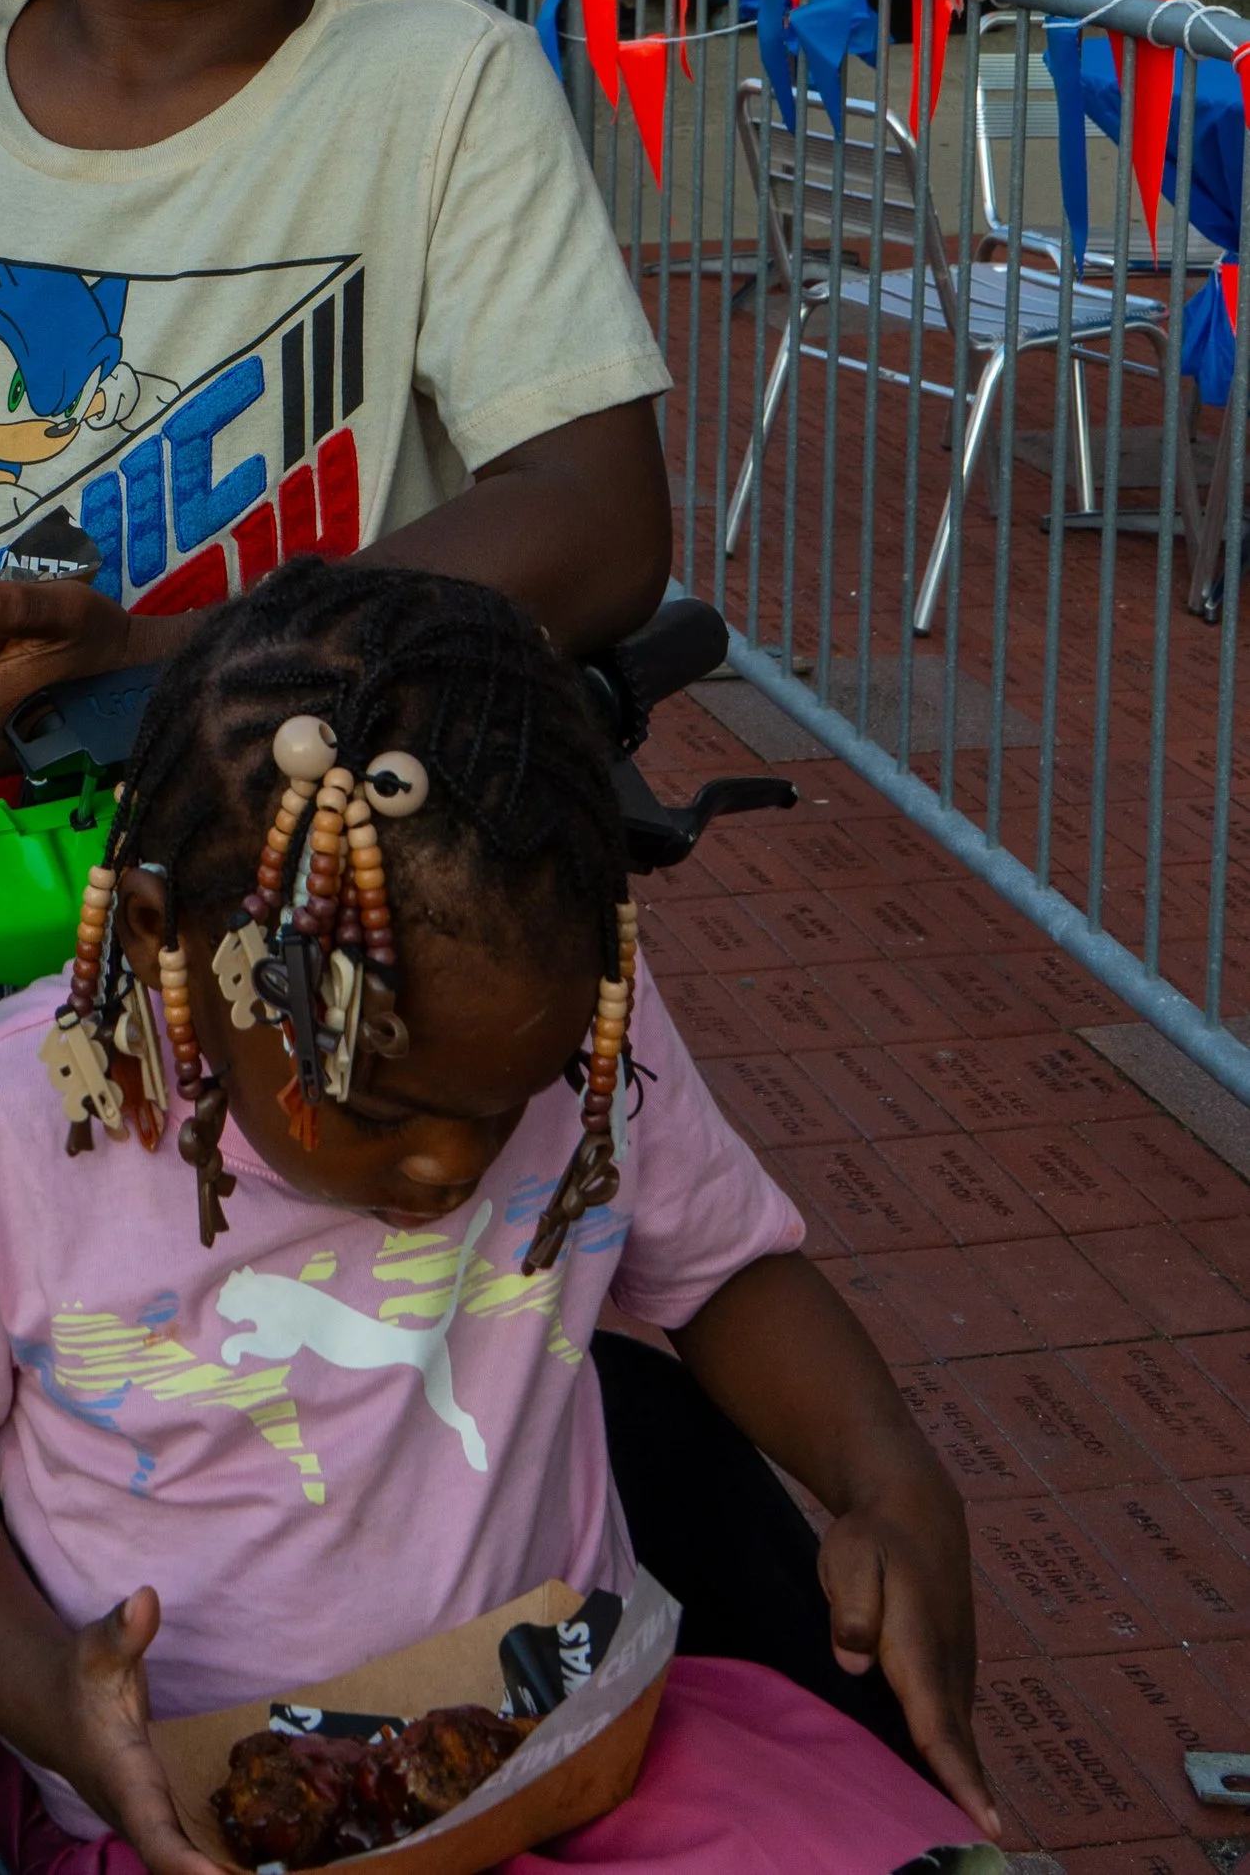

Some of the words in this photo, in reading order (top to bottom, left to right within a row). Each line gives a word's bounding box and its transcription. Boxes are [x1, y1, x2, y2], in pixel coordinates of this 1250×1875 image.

[728, 1062, 772, 1096] ARLENE
[763, 1101, 806, 1135] VICTOR
[765, 1078, 810, 1112] MEMORY
[832, 1052, 883, 1091] MILDRED
[830, 1152, 884, 1198] ANGELINA
[872, 1202, 914, 1233] DALLA
[1119, 1502, 1170, 1542] MARY
[1018, 1539, 1086, 1604] CASIMIR
[1022, 1508, 1050, 1522] IN
[1041, 1533, 1115, 1601] MEMORY
[1105, 1611, 1141, 1633] OF
[988, 1680, 1044, 1732] CAROL
[1117, 1662, 1171, 1704] JEAN
[1018, 1677, 1077, 1731] OPERA
[1064, 1739, 1138, 1811] BUDDIES
